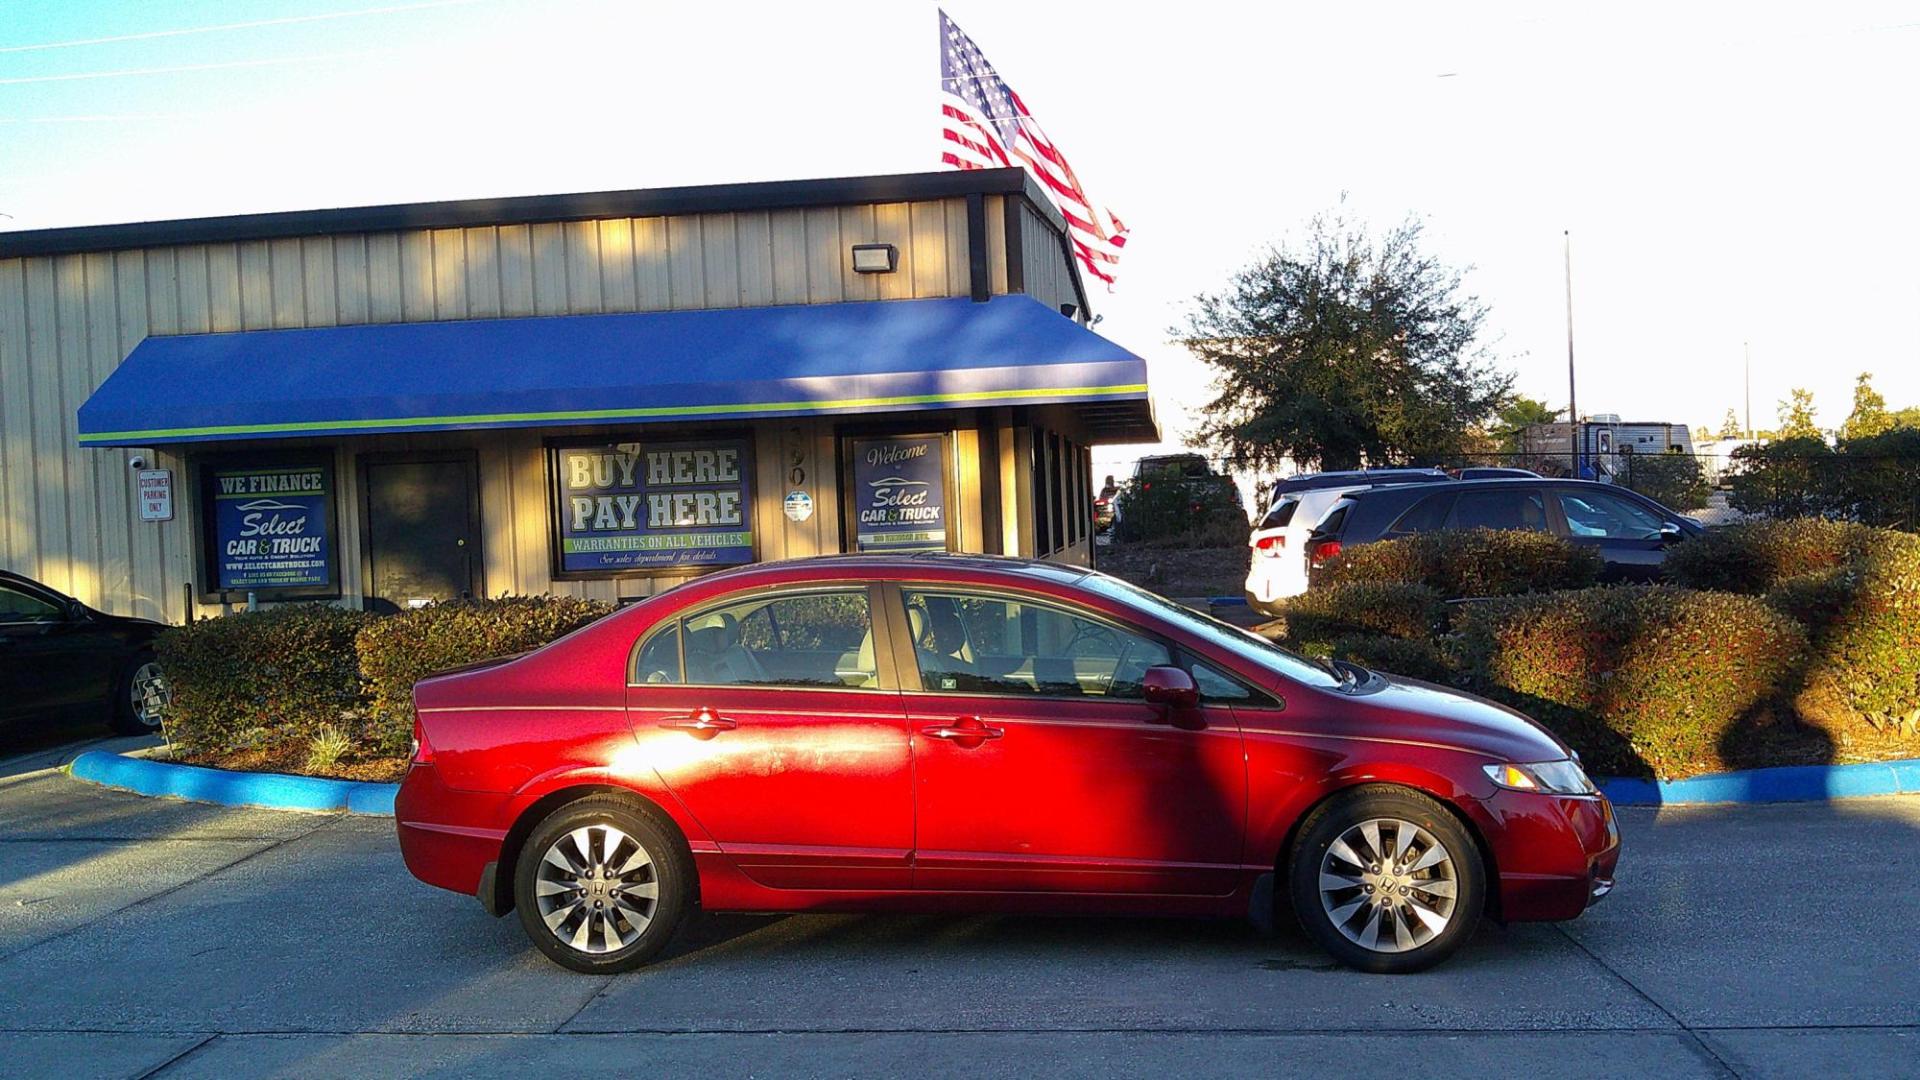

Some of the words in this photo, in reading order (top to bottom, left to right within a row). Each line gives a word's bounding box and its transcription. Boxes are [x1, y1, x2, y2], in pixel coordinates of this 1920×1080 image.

[867, 444, 927, 467] Welcome
[568, 452, 639, 488] BUY
[647, 450, 740, 485] HERE
[220, 476, 246, 494] WE
[249, 473, 322, 492] FINANCE
[143, 490, 167, 500] PARKING
[873, 488, 927, 507] Select
[149, 502, 162, 512] ONLY
[571, 494, 640, 531] PAY
[648, 492, 741, 526] HERE
[861, 509, 886, 522] CAR
[888, 508, 897, 522] &
[900, 506, 940, 520] TRUCK
[240, 512, 306, 537] Select
[226, 539, 257, 556] CAR
[259, 538, 271, 554] &
[272, 538, 321, 553] TRUCK
[573, 538, 649, 551] WARRANTIES
[649, 537, 662, 547] ON
[666, 535, 687, 547] ALL
[690, 532, 744, 546] VEHICLES
[635, 551, 675, 564] department
